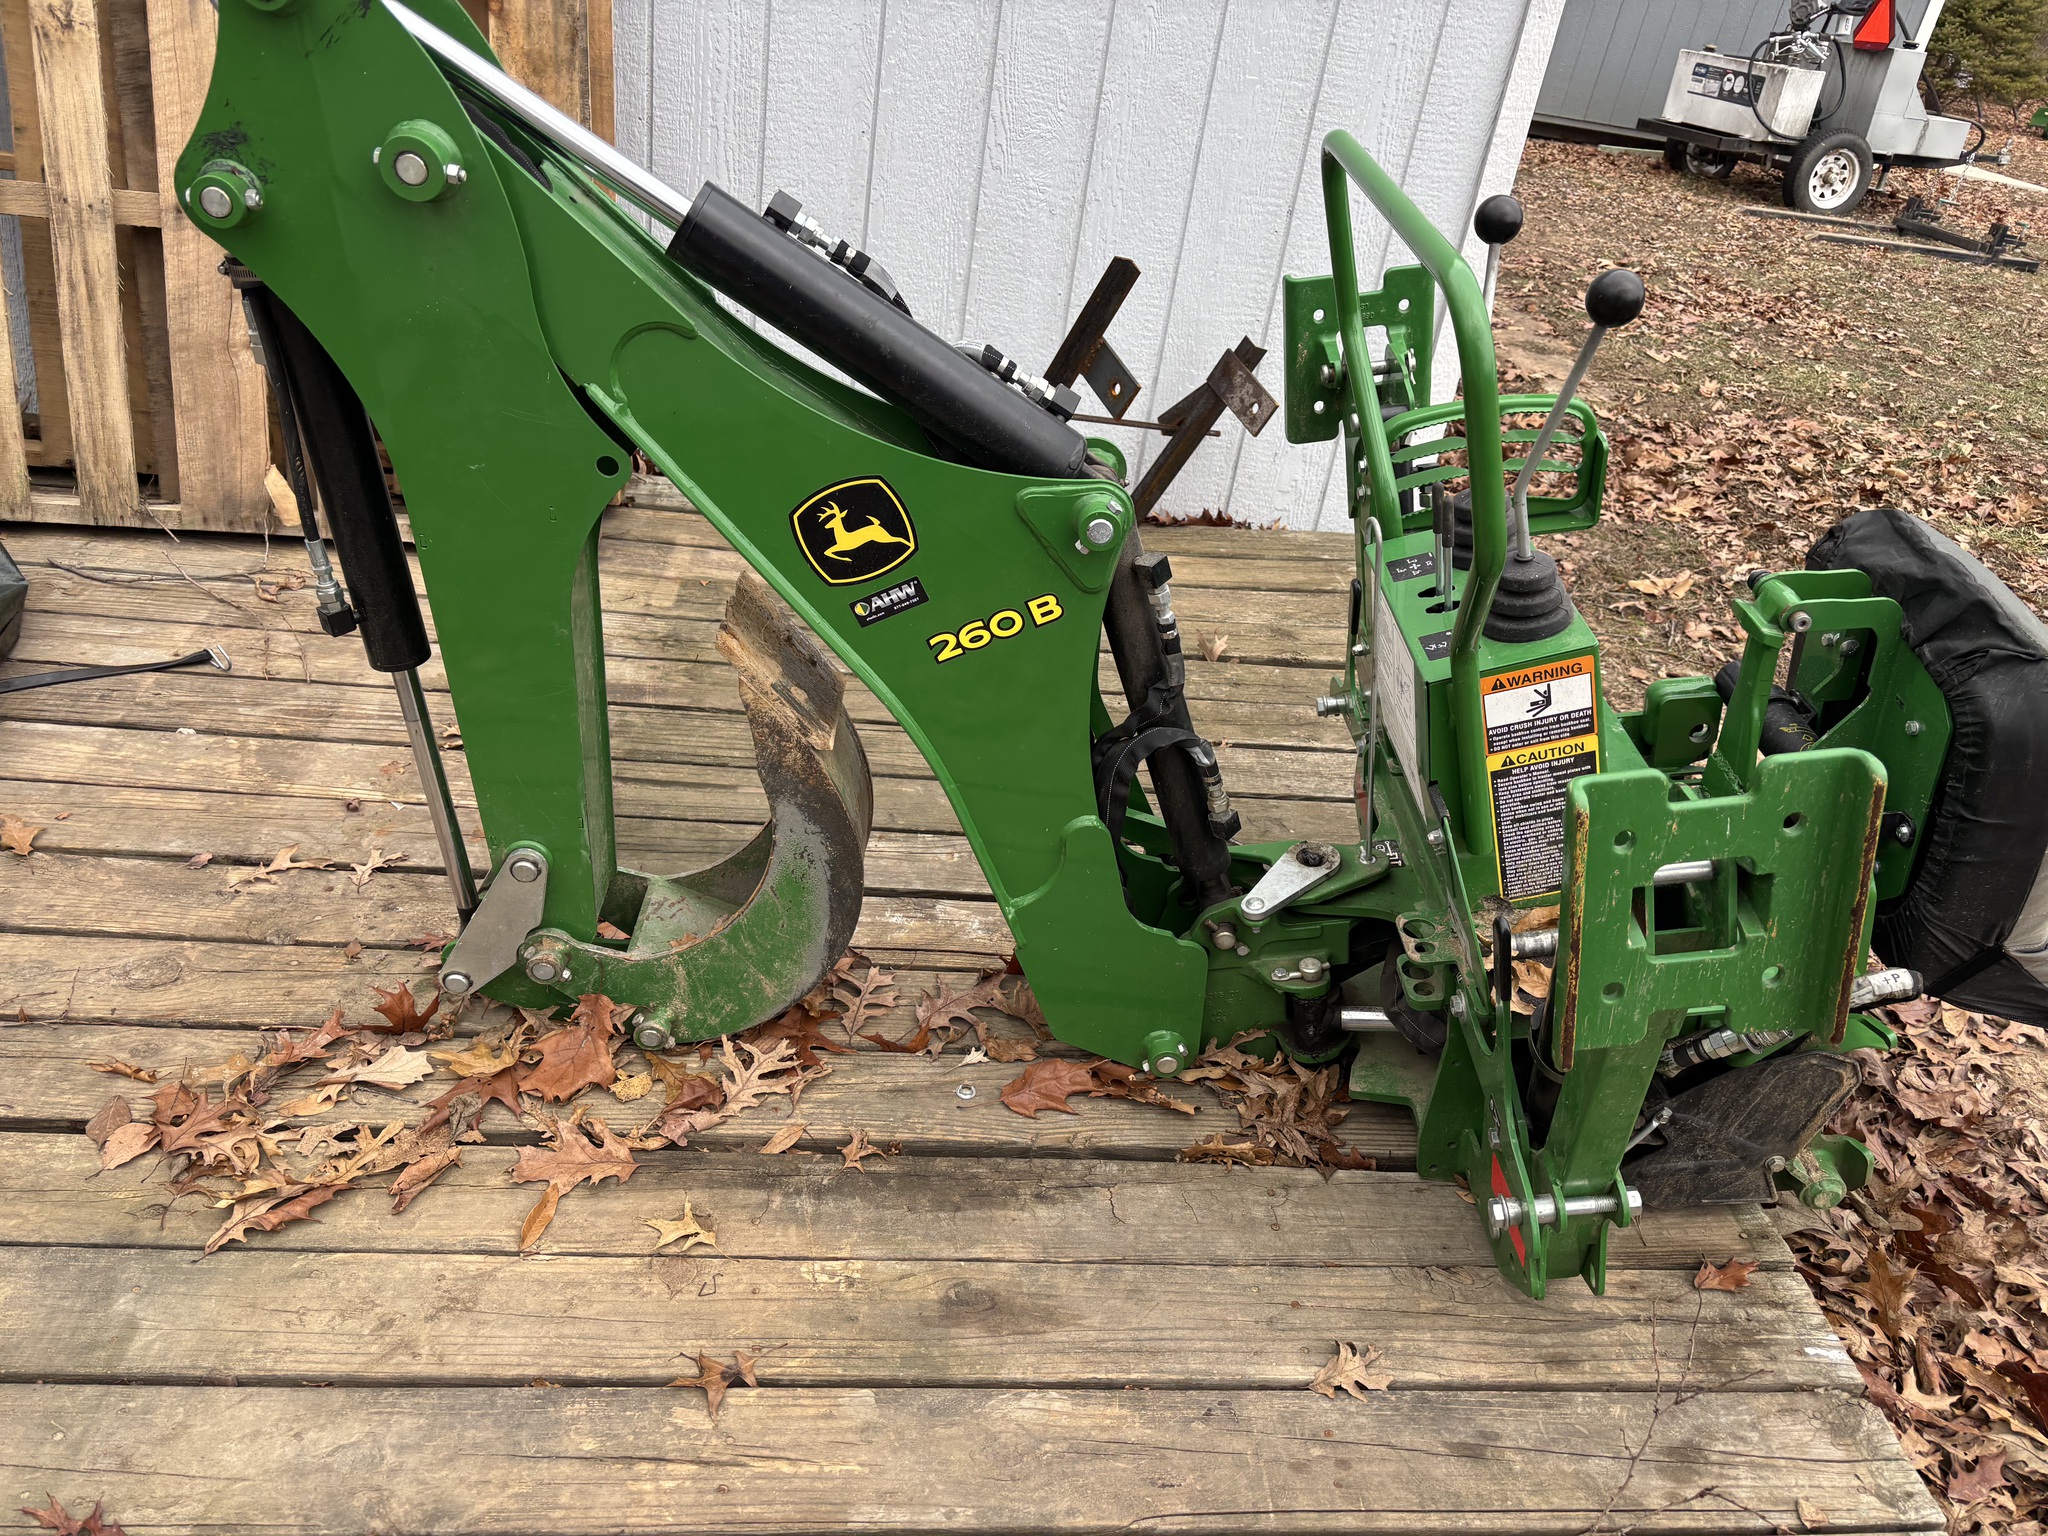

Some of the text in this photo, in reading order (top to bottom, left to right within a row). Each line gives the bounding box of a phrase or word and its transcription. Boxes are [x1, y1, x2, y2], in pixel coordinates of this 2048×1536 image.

[871, 581, 916, 612] AHW
[926, 593, 1065, 664] 260 B
[1506, 662, 1582, 688] WARNING
[1488, 726, 1508, 735] AVOID
[1509, 721, 1532, 731] CRUSH
[1534, 716, 1557, 726] INJURY
[1570, 709, 1591, 718] DEATH
[1511, 757, 1574, 774] HELP AVOID INJURY
[1516, 741, 1584, 764] CAUTION
